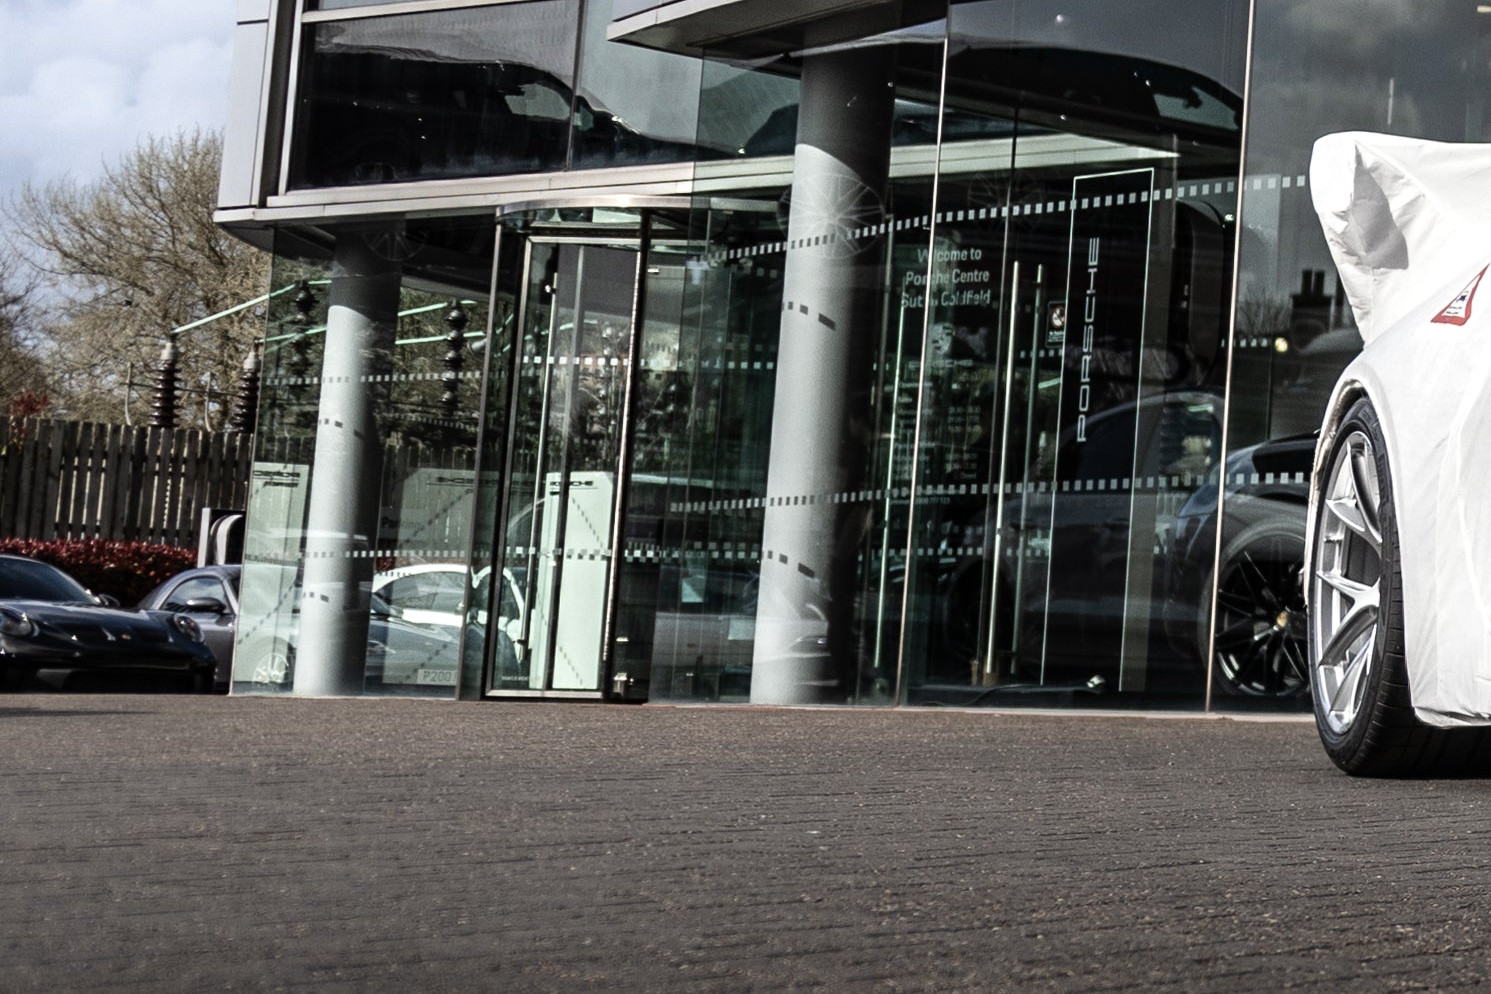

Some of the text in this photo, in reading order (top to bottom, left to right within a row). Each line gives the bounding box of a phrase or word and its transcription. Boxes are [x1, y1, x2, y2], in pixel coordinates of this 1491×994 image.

[970, 247, 982, 261] to
[905, 268, 990, 286] Porche Centre
[1076, 237, 1100, 443] PORSCHE
